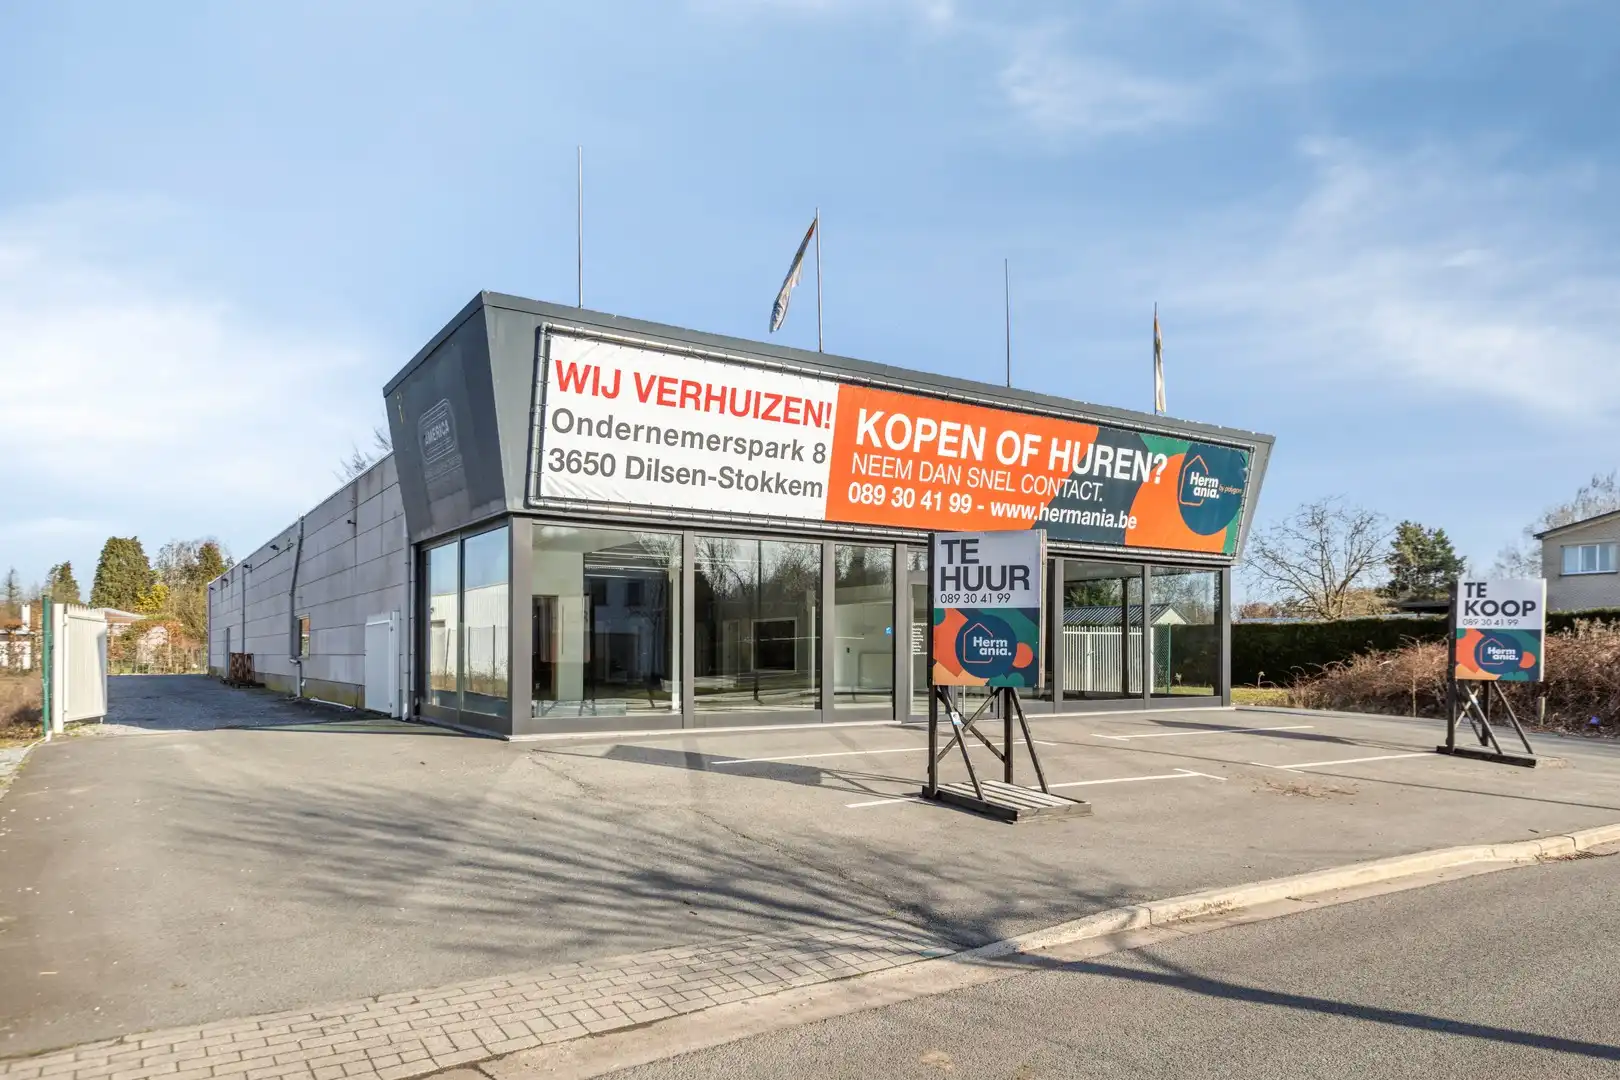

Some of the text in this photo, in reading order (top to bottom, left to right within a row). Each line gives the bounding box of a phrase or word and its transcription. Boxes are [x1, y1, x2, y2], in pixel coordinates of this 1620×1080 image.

[555, 360, 832, 429] WIJ VERHUIZEN!
[552, 408, 826, 464] Ondernemerspark 8
[856, 408, 1168, 485] KOPEN OF HUREN?
[548, 448, 823, 498] 3650 Dilsen-Stokkem
[852, 452, 1104, 502] NEEM DAN SNEL CONTACT.
[1190, 472, 1219, 488] Herm
[1193, 486, 1219, 499] ania.
[848, 481, 886, 505] 089
[891, 486, 915, 508] 30
[920, 490, 942, 511] 41
[949, 492, 972, 514] 99
[991, 501, 1137, 529] www.hermania.be
[940, 539, 979, 564] TE
[940, 565, 1029, 591] HUUR
[940, 593, 1011, 604] 089 30 41 99
[1464, 582, 1487, 598] TE
[1464, 600, 1536, 617] KOOP
[973, 637, 1008, 648] Herm
[979, 644, 1012, 656] ania.
[1487, 647, 1516, 655] Herm
